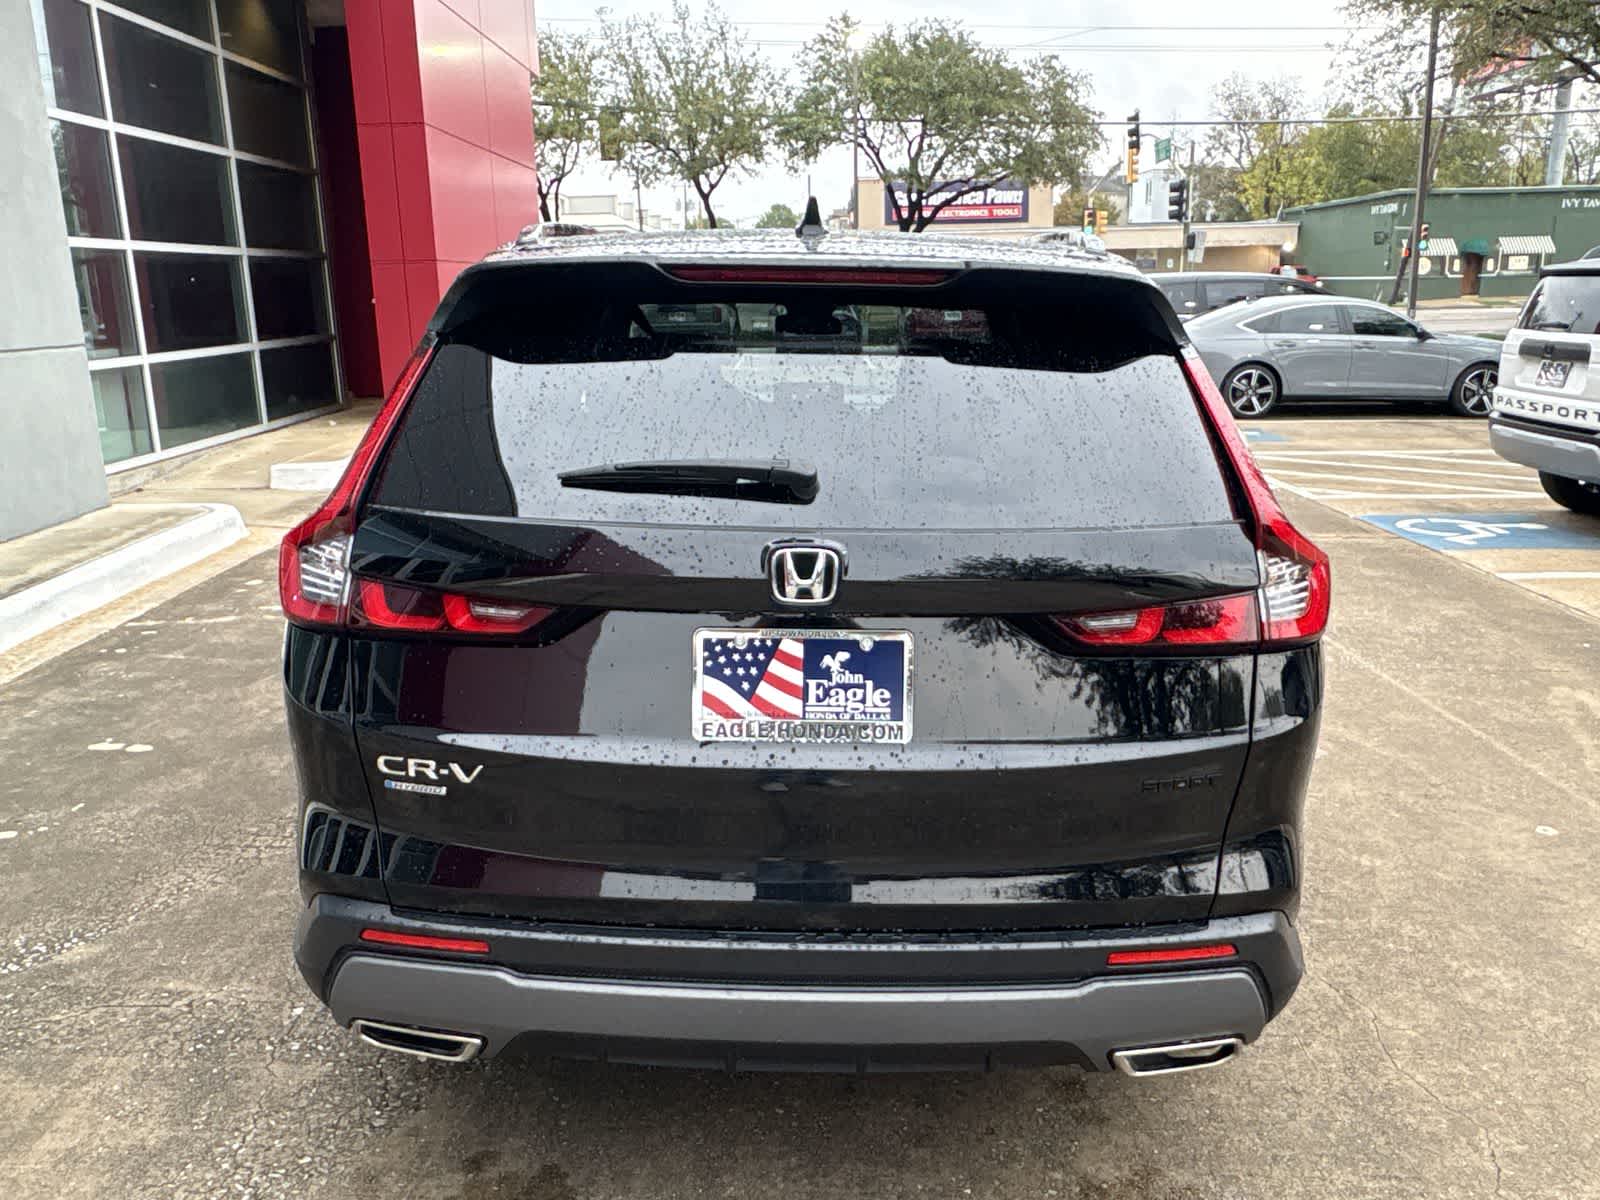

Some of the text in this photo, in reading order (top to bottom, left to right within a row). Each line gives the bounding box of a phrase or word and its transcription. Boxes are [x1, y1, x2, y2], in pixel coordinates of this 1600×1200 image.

[986, 188, 1024, 204] Pawn
[1561, 198, 1581, 209] IVY
[992, 206, 1019, 216] TOOLS
[1496, 395, 1600, 422] PASSPORT
[829, 671, 864, 687] John
[805, 679, 892, 713] Eagle
[805, 712, 837, 720] HONDA
[839, 712, 852, 720] OF
[854, 712, 891, 720] DALLAS
[376, 754, 484, 784] CR-V
